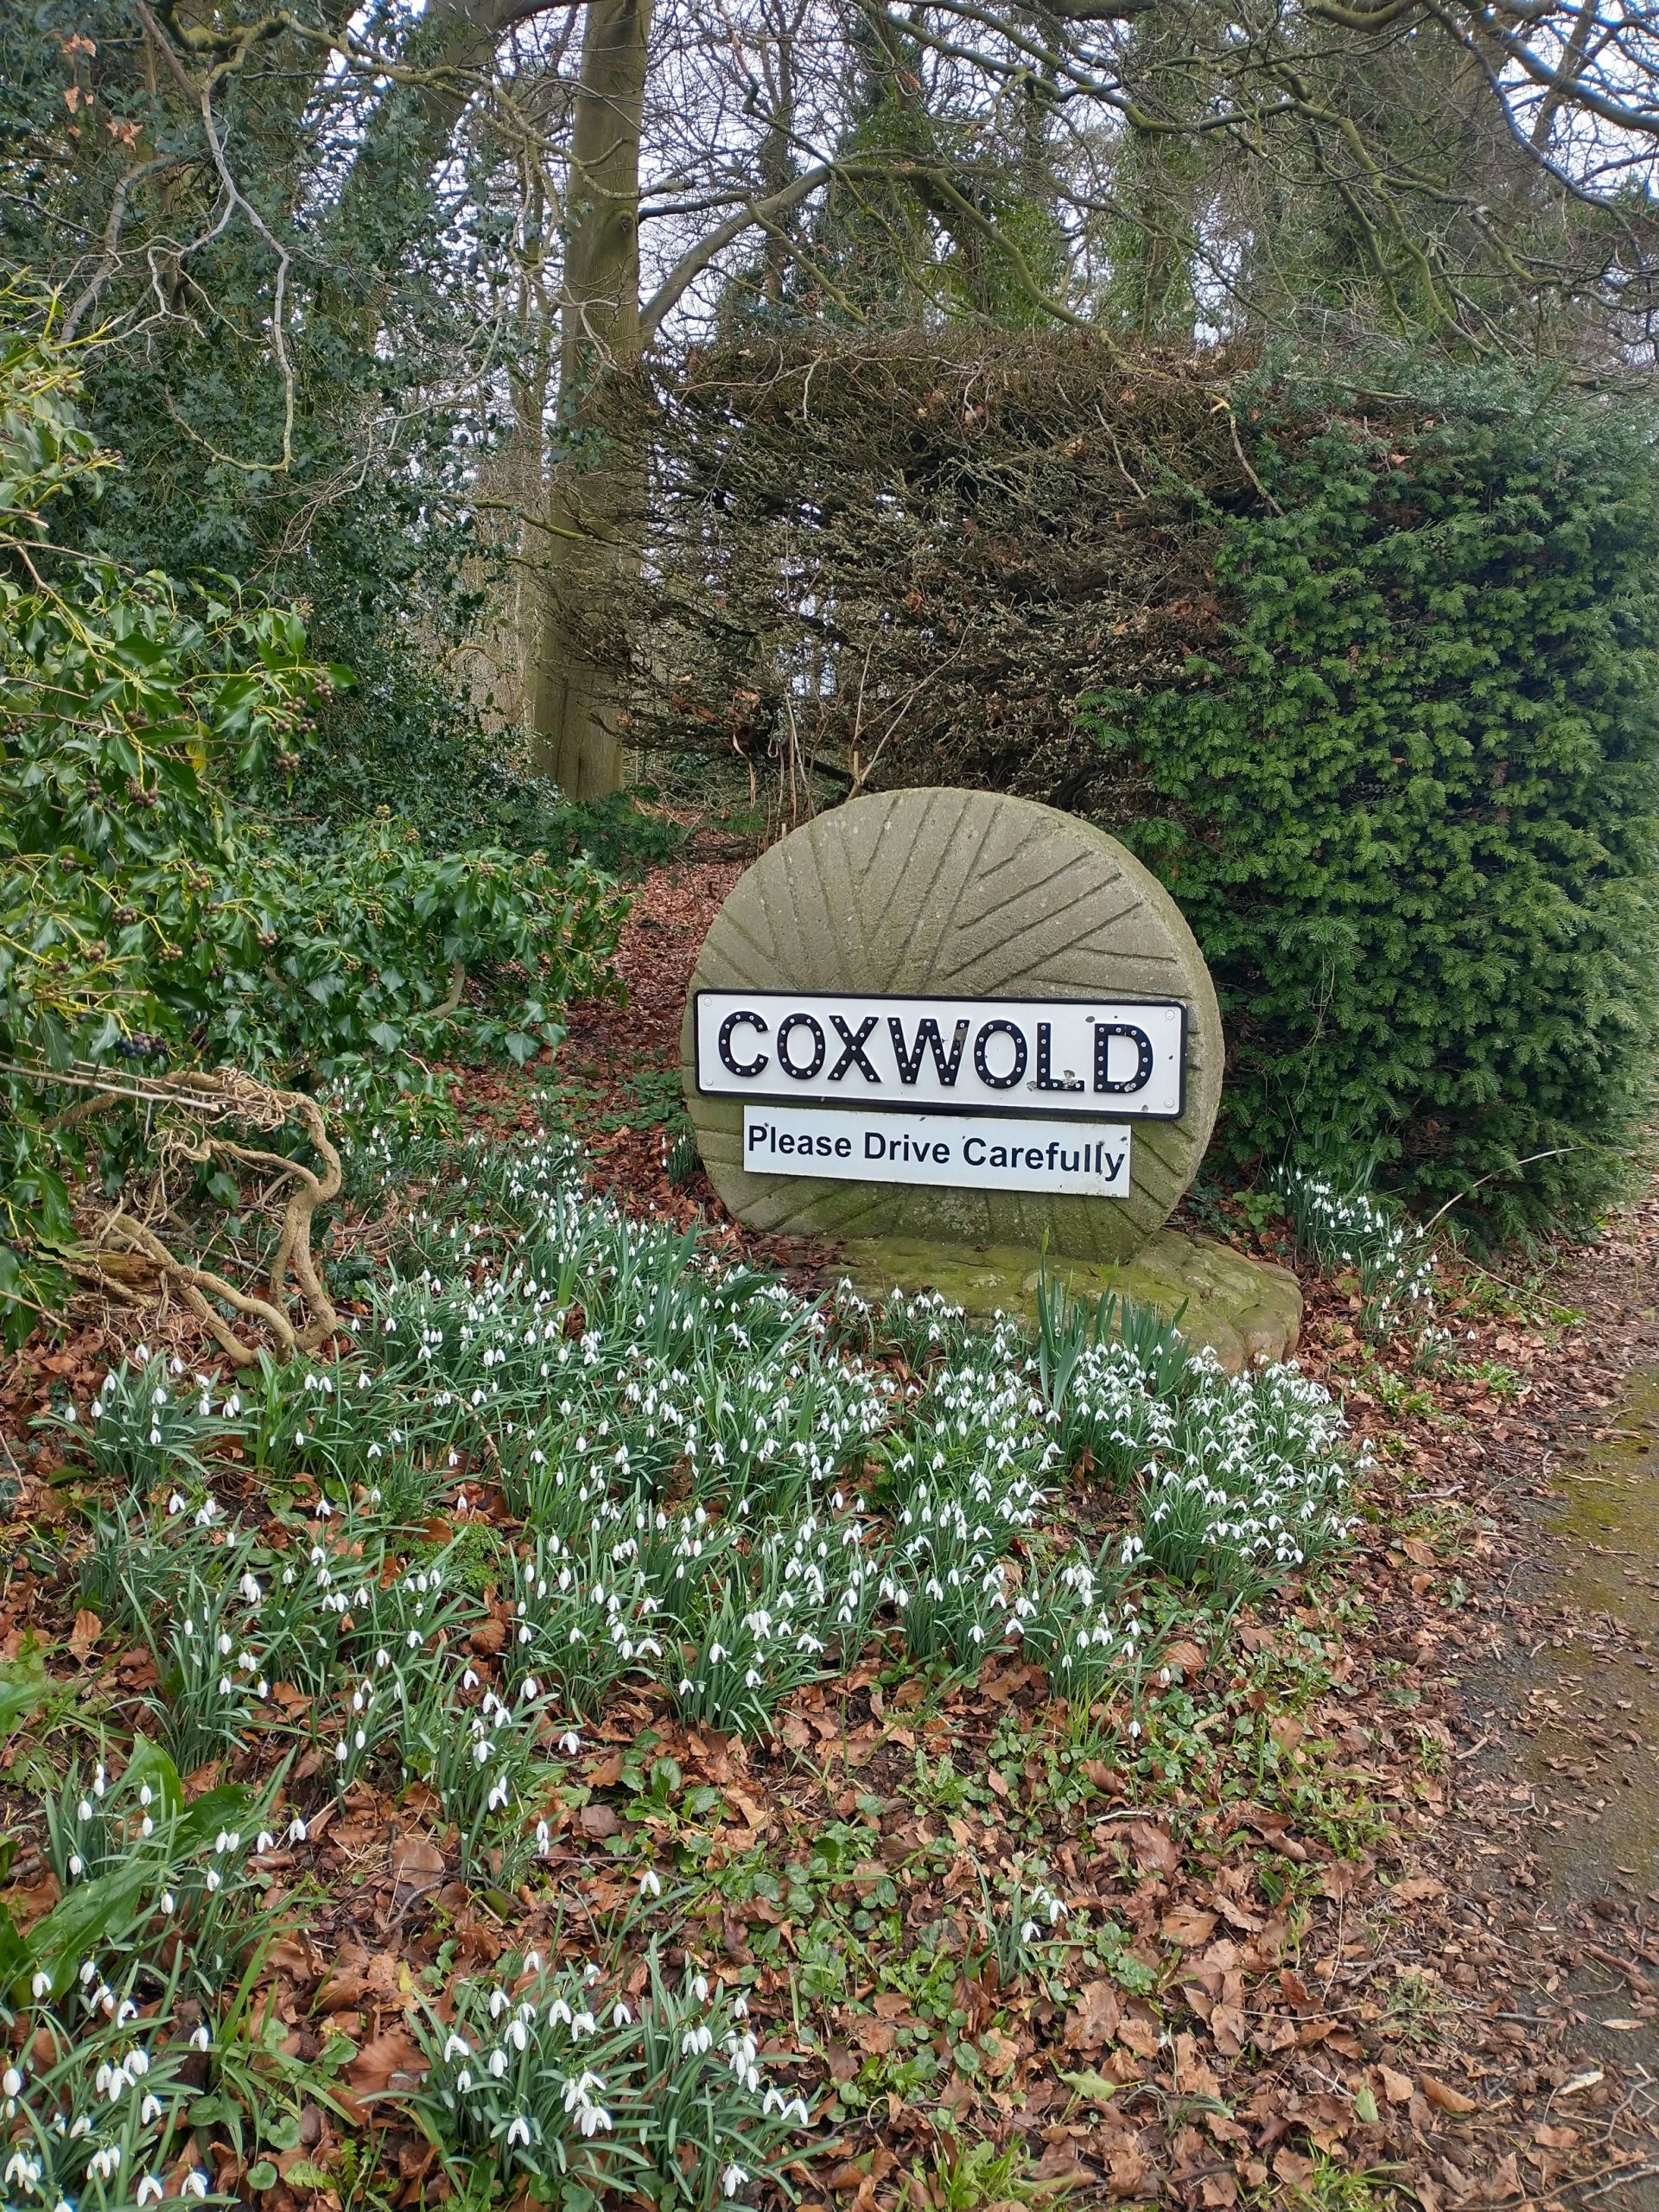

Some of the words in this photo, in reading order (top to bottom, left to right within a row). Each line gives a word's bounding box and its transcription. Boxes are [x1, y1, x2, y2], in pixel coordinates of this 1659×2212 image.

[718, 1010, 1154, 1094] COXWOLD
[748, 1125, 852, 1158] Please
[864, 1131, 950, 1164] Drive
[963, 1137, 1126, 1182] Carefully
